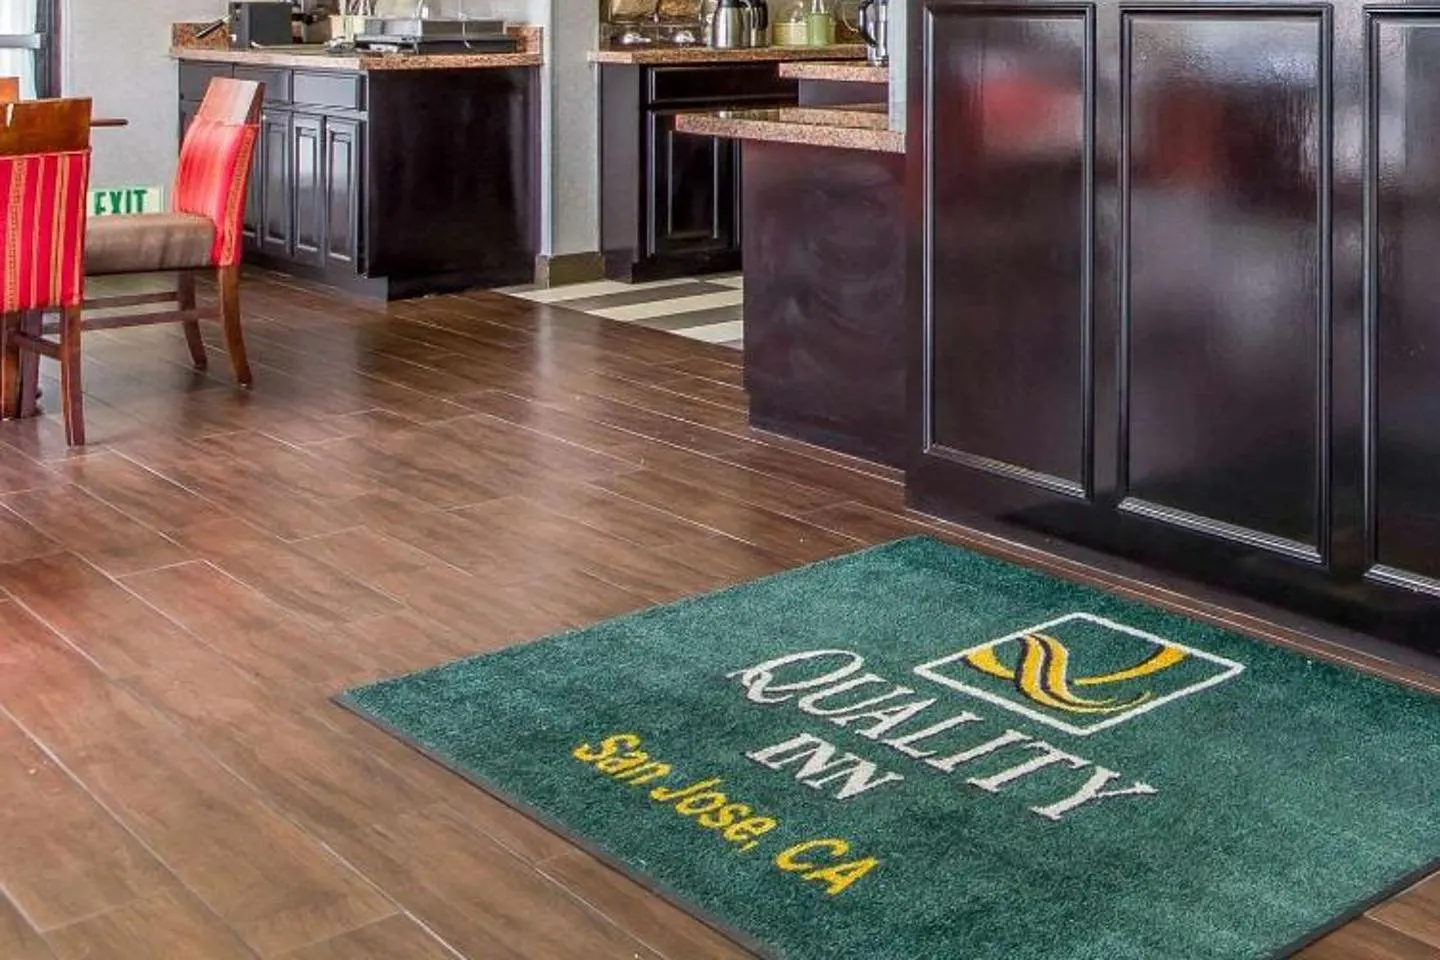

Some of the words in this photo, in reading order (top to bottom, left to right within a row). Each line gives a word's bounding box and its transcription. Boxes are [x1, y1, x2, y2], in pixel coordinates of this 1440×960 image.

[94, 190, 148, 215] EXIT
[728, 648, 1159, 821] QUALITY
[746, 732, 904, 800] INN
[573, 732, 672, 789] San
[651, 777, 779, 852] Jose,
[775, 839, 881, 897] CA
